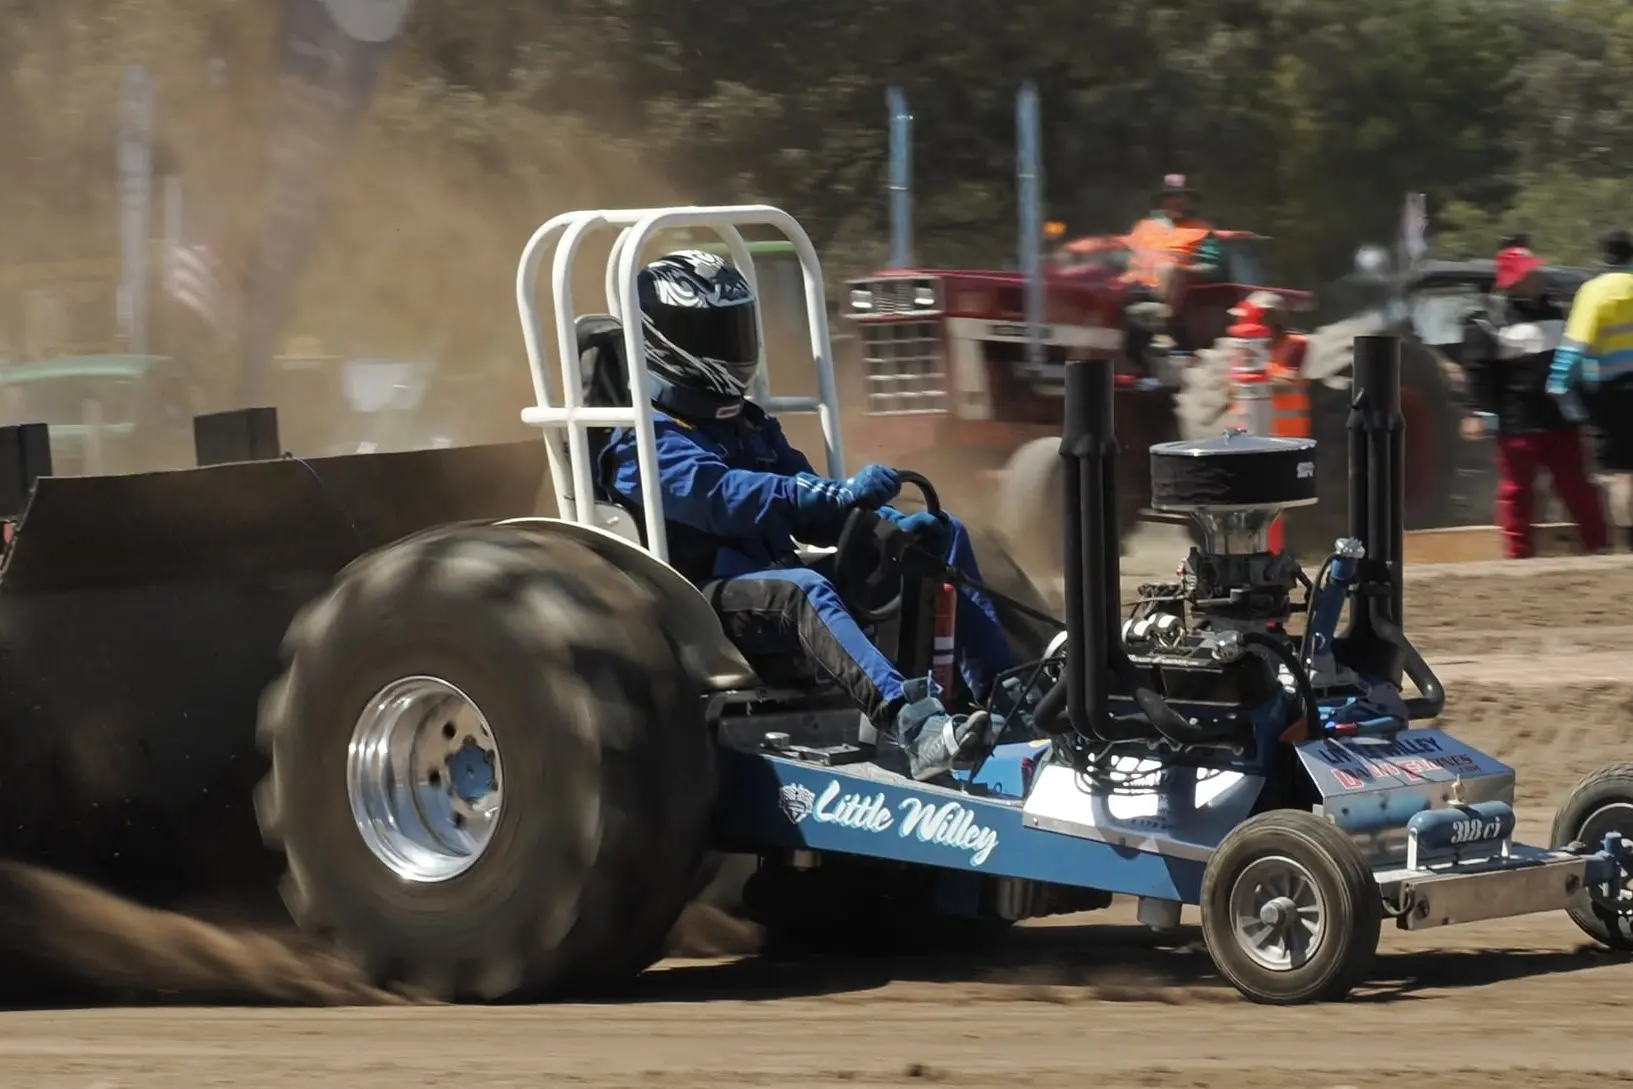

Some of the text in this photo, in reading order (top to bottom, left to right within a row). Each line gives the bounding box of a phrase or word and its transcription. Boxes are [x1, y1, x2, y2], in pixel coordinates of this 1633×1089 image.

[814, 780, 999, 866] Little Willey
[1451, 816, 1501, 844] 318 ci
